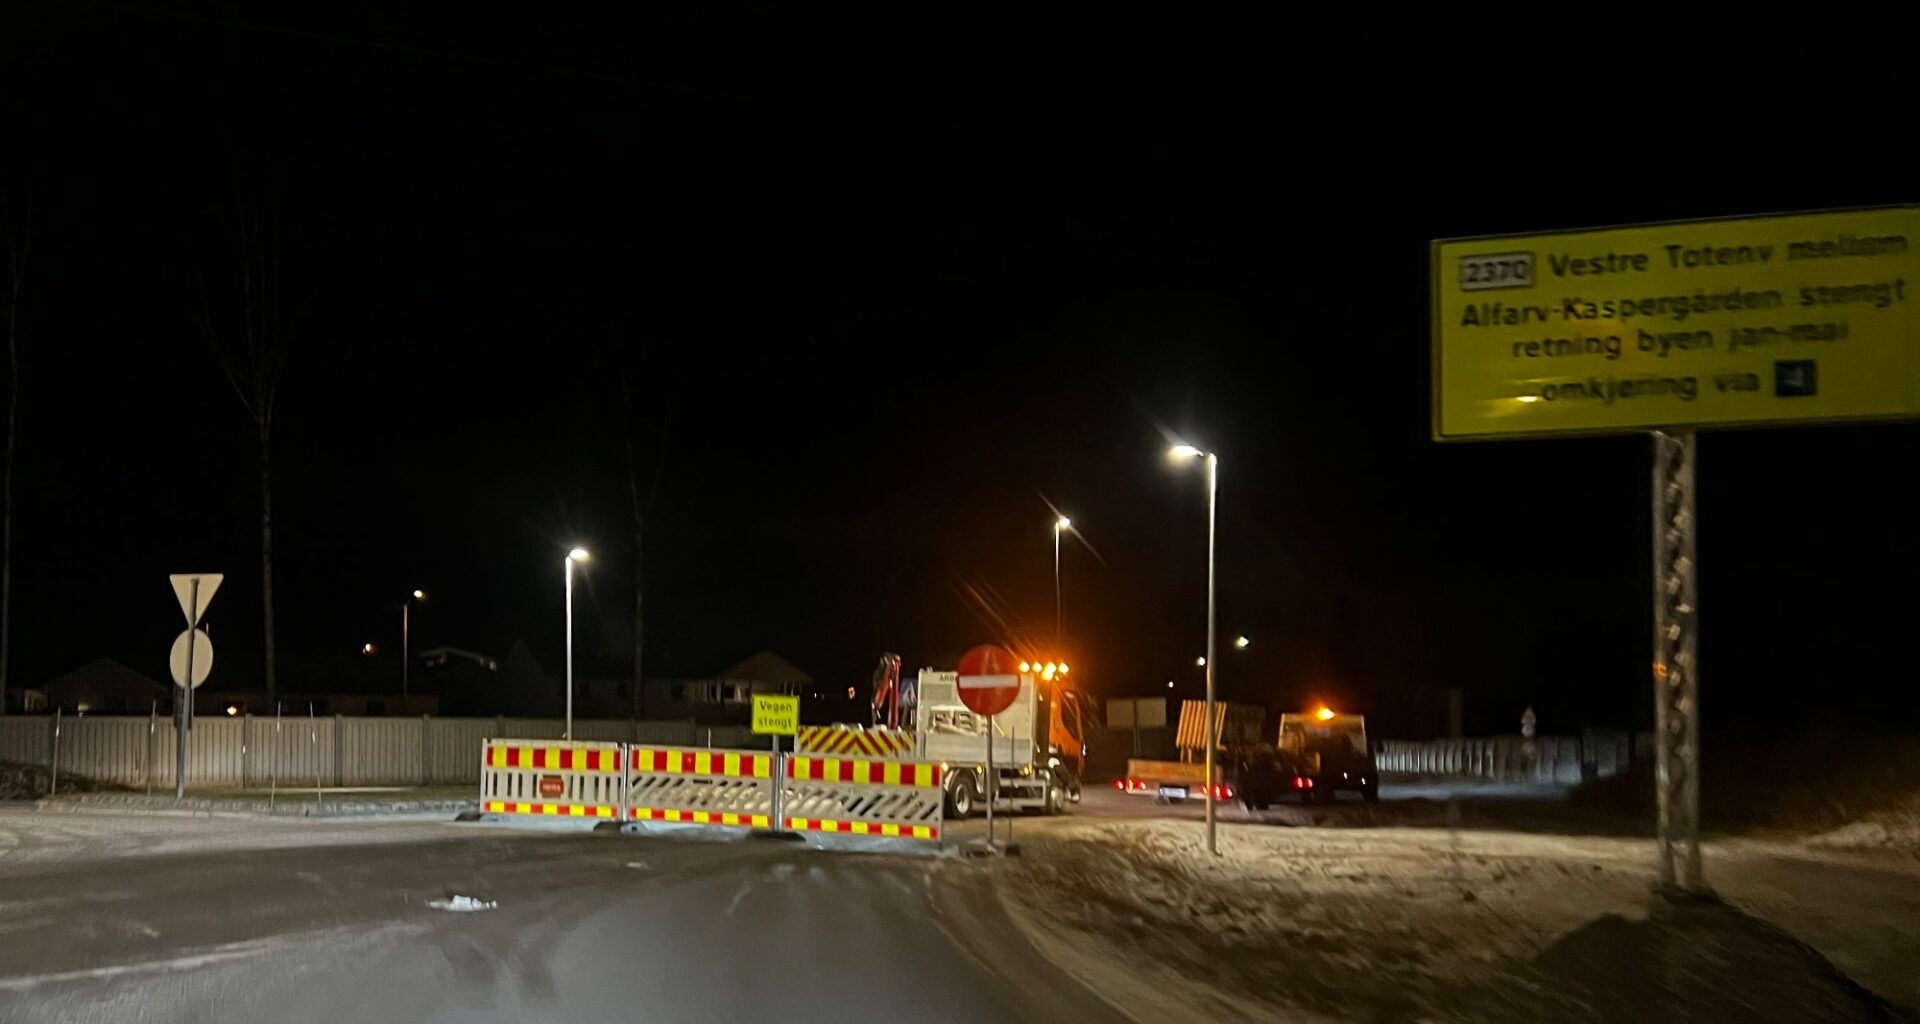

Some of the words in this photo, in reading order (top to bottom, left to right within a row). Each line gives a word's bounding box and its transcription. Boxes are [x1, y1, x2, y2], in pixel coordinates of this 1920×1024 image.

[1465, 260, 1528, 283] 2370
[1549, 251, 1649, 278] Vestre
[1665, 243, 1774, 268] Totenv
[1800, 278, 1905, 308] stengt
[1512, 333, 1621, 360] retning
[1637, 328, 1712, 357] byen
[1713, 371, 1760, 392] via
[759, 700, 792, 713] Vegen
[758, 716, 792, 729] stengt
